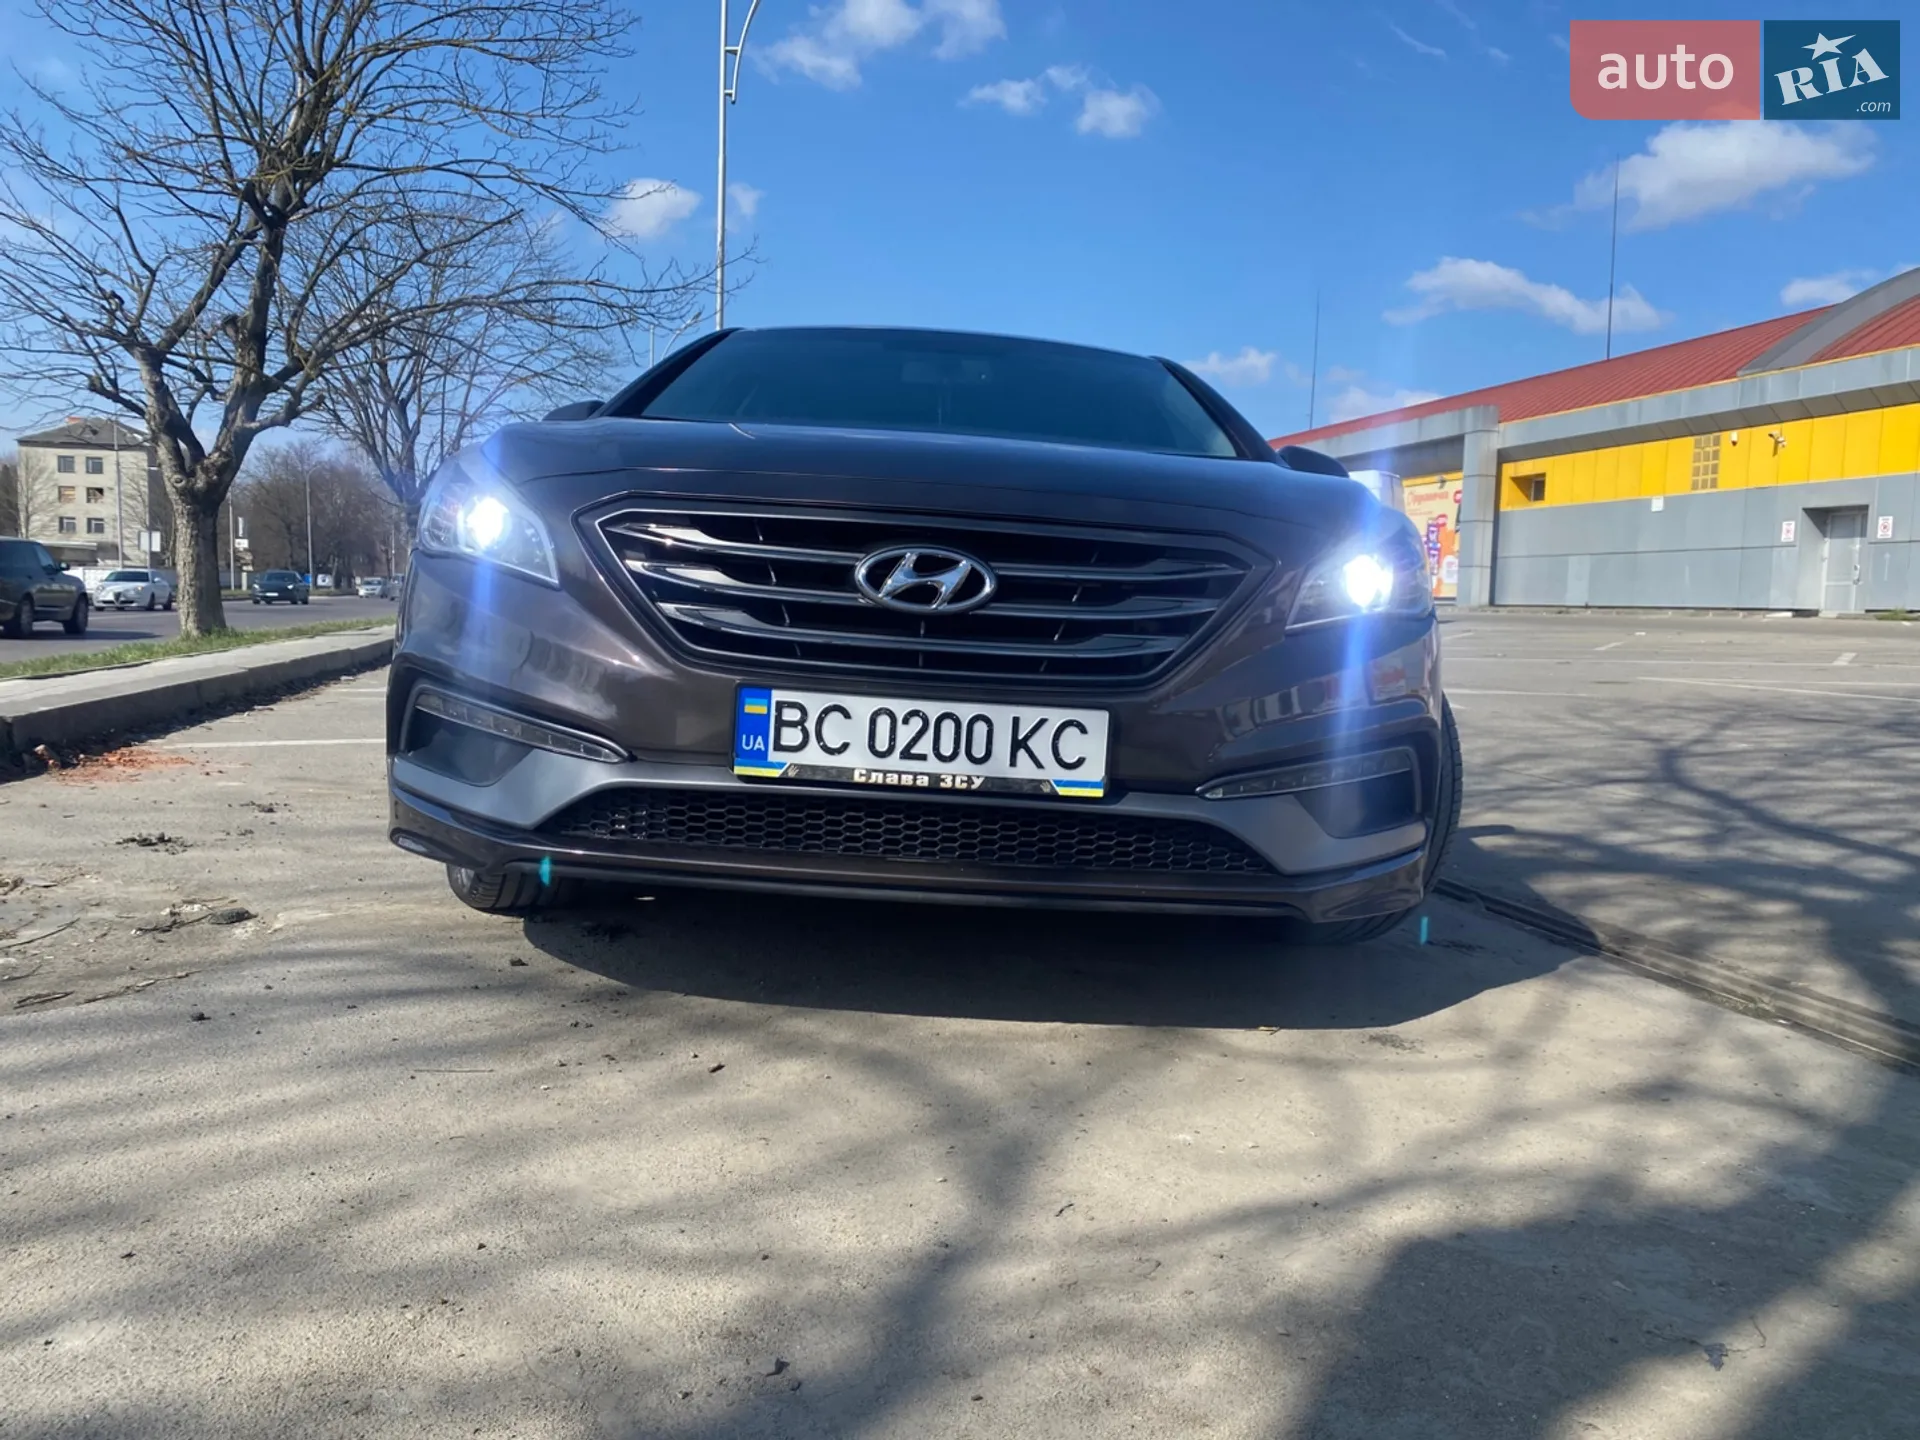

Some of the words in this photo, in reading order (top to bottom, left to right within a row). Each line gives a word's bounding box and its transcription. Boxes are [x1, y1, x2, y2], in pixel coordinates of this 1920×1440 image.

[741, 734, 766, 751] UA
[772, 699, 852, 756] BC
[867, 706, 995, 766] 0200
[1008, 715, 1089, 771] KC
[853, 768, 930, 787] Слава
